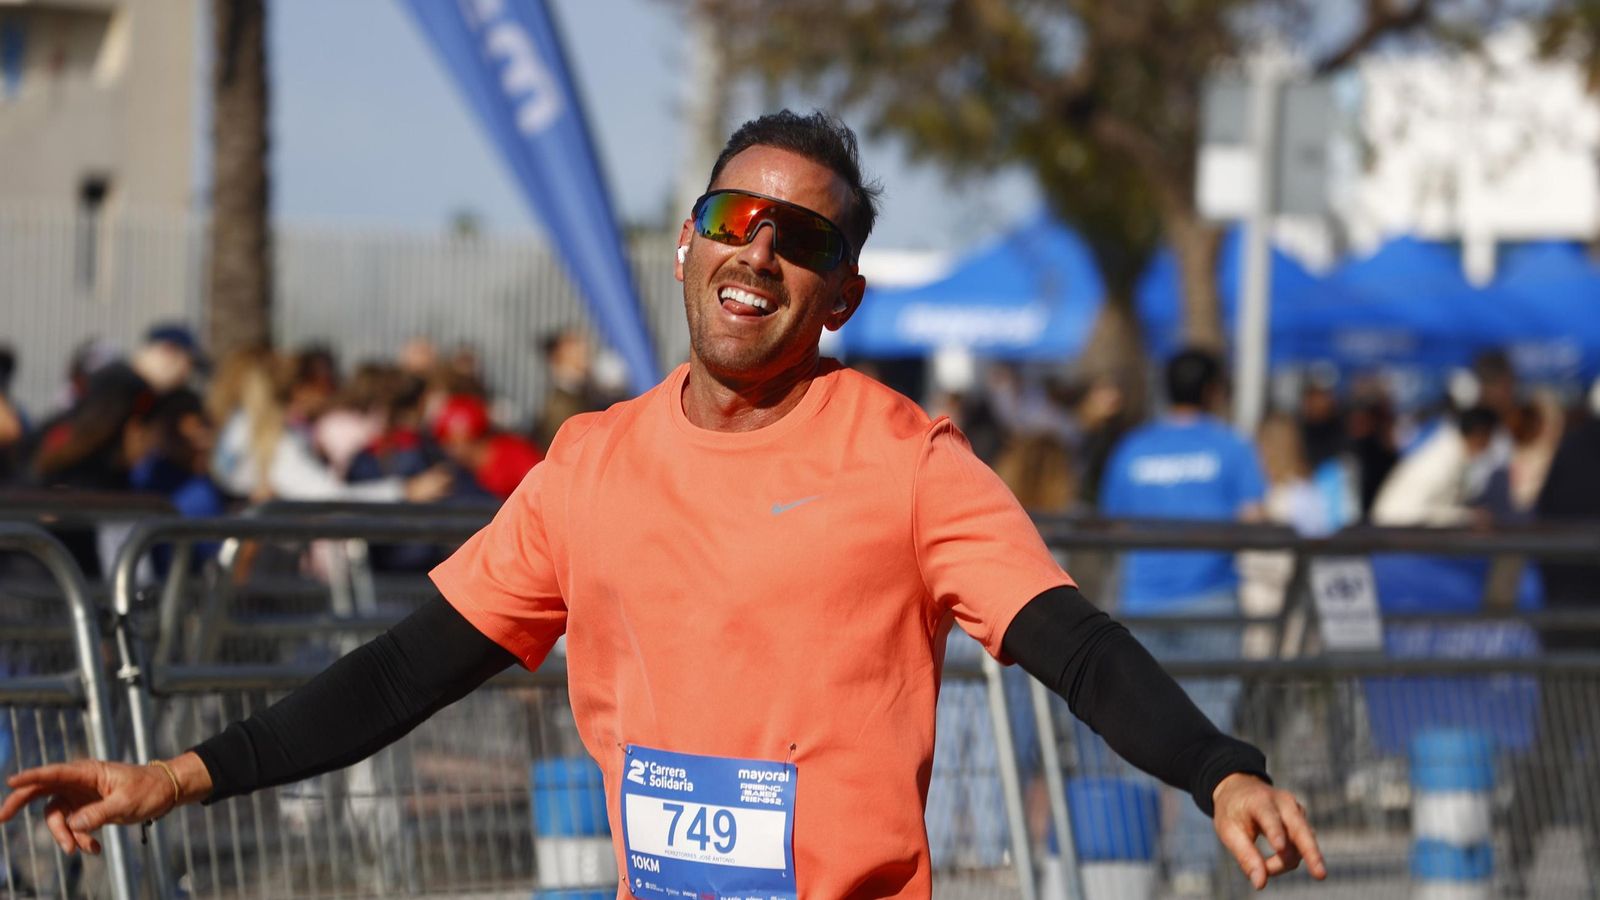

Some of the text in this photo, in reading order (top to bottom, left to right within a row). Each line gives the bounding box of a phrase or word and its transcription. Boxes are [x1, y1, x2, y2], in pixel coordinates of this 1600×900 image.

[649, 761, 687, 779] Carrera
[738, 769, 790, 784] mayoral
[649, 774, 694, 792] Solidaria
[663, 802, 737, 854] 749
[631, 854, 660, 873] 10KM
